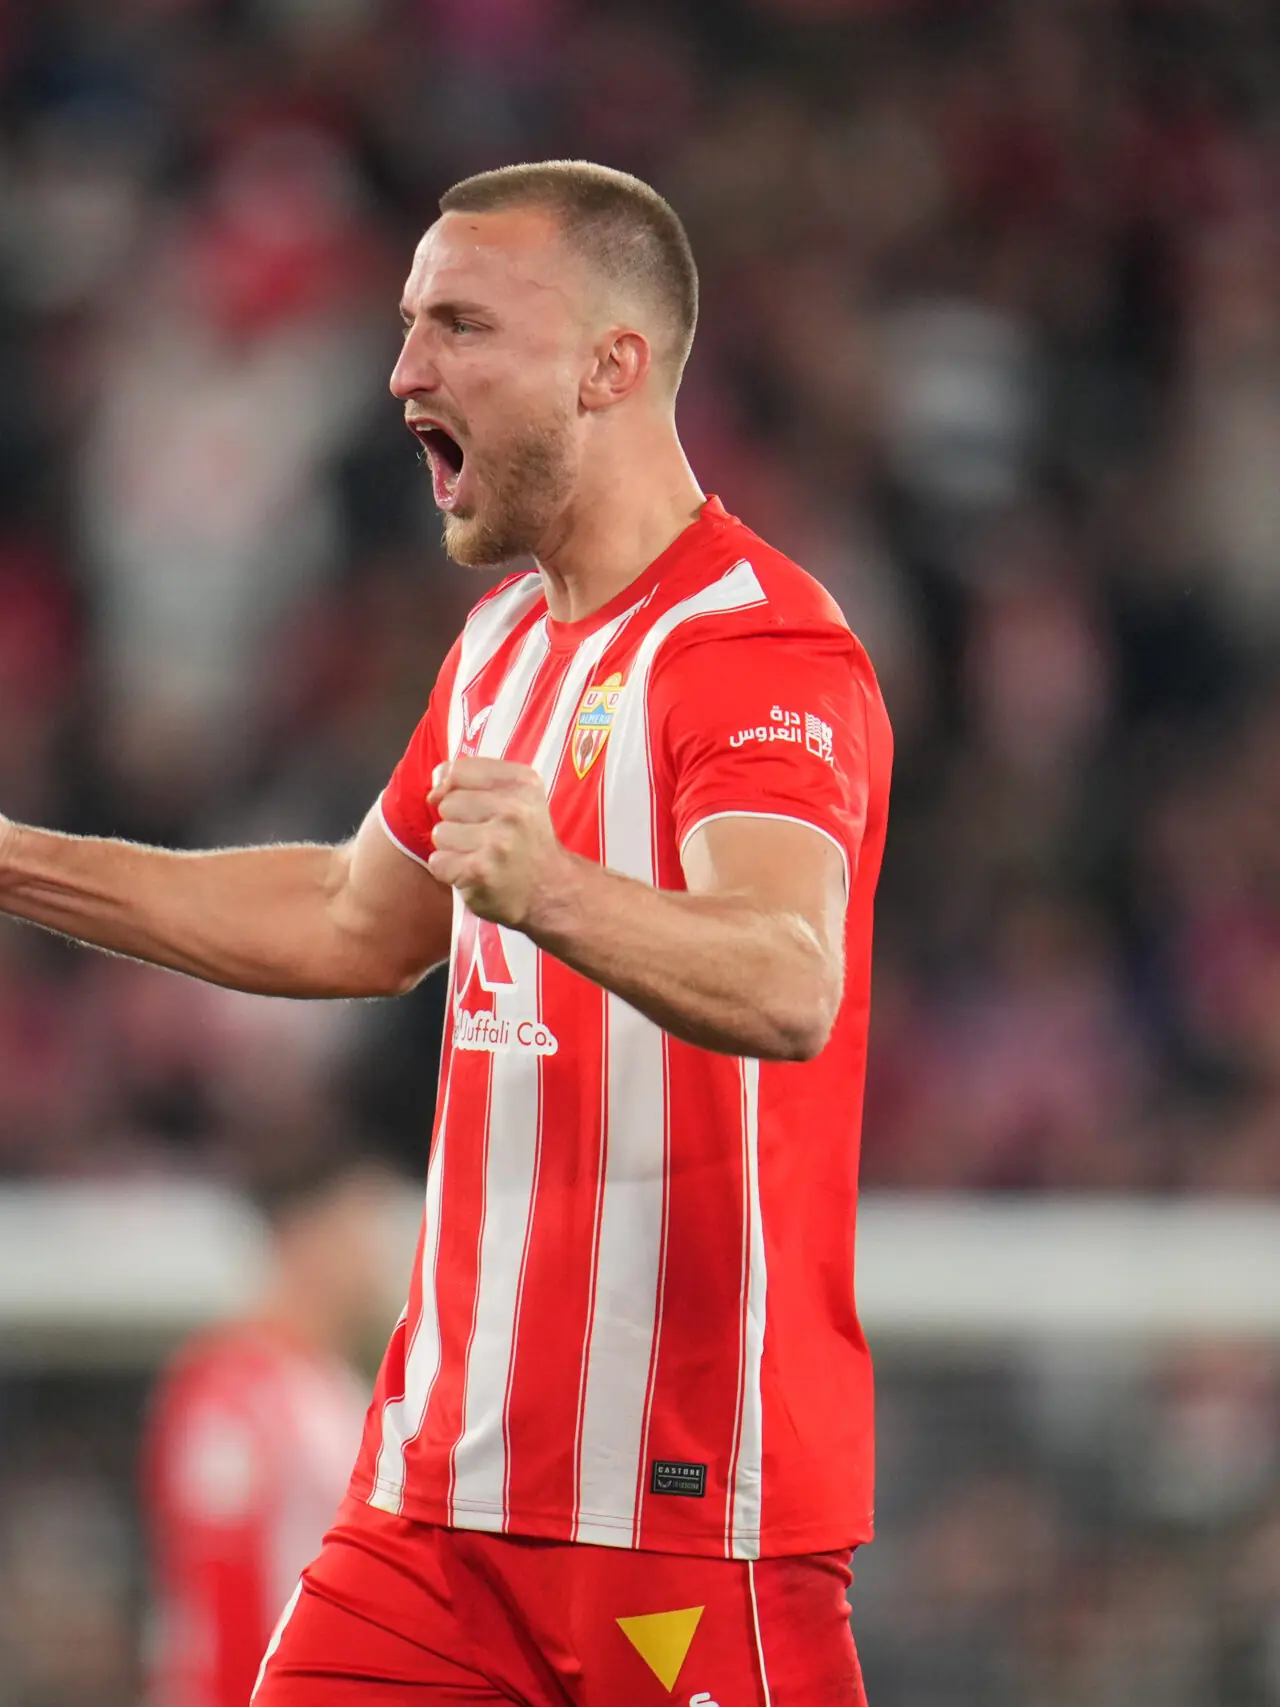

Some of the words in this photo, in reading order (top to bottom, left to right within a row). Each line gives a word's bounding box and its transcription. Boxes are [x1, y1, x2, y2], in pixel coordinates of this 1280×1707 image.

[770, 705, 801, 727] درة
[729, 726, 802, 748] العروس
[461, 1016, 510, 1045] Juffali
[517, 1021, 552, 1047] Co.
